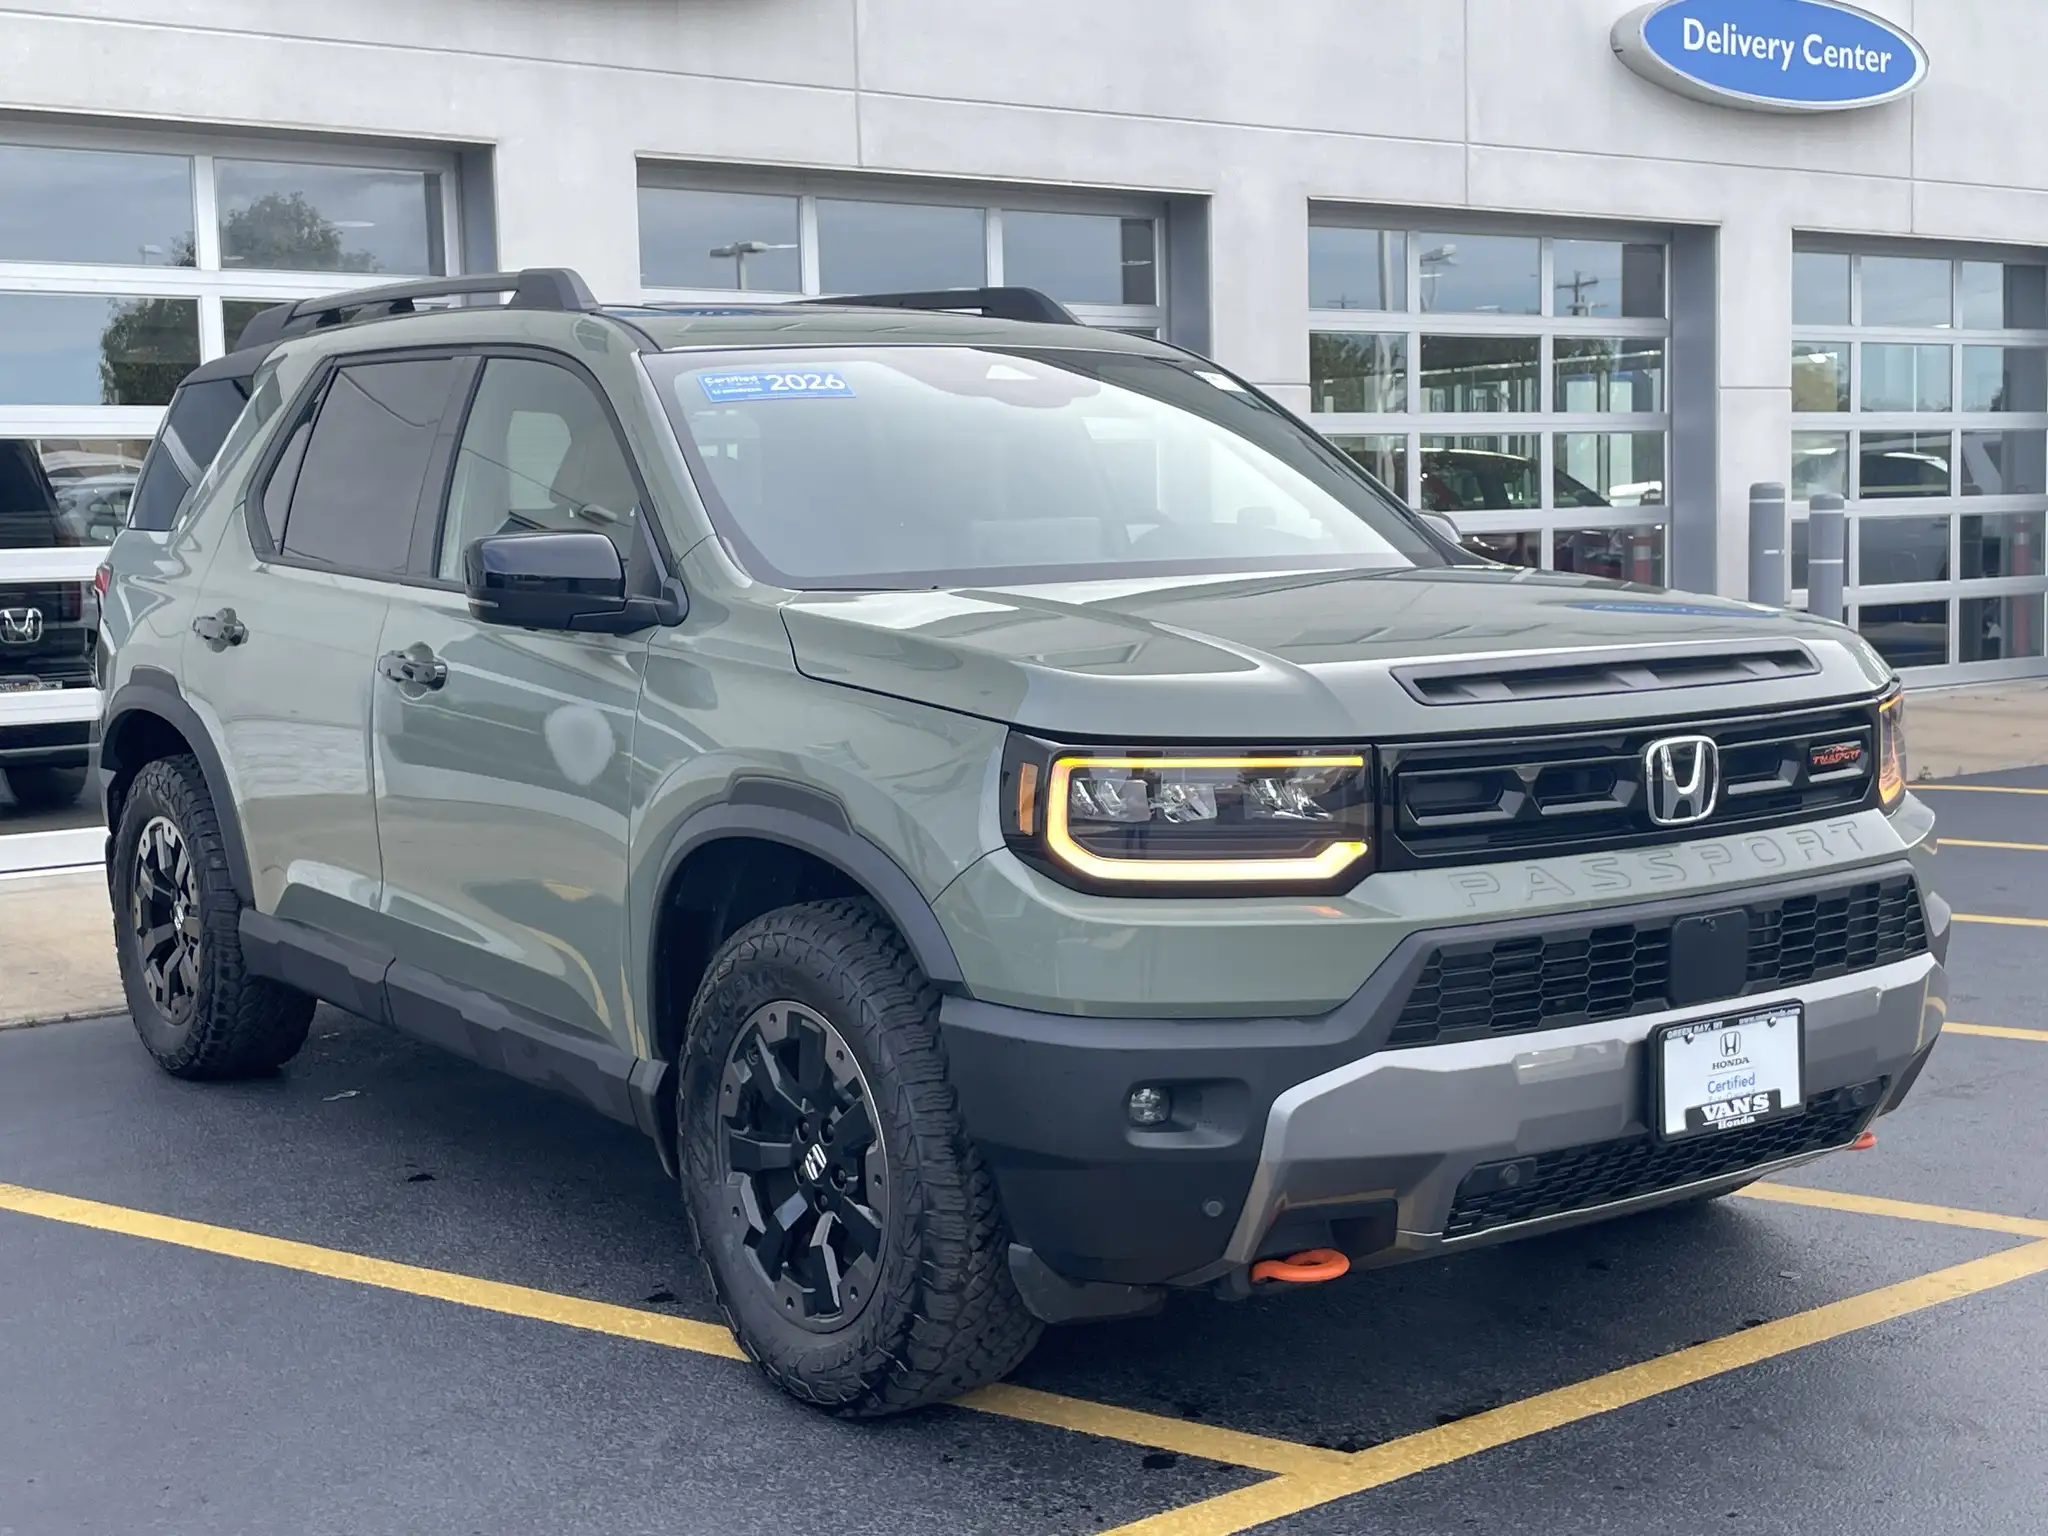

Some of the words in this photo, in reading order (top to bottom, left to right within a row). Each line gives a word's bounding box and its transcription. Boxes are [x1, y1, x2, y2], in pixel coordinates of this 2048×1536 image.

[1683, 17, 1795, 71] Delivery
[1802, 34, 1892, 73] Center
[765, 374, 846, 391] 2026
[1447, 821, 1865, 908] PASSPORT
[1712, 1057, 1750, 1070] HONDA
[1708, 1071, 1755, 1093] Certified
[1701, 1093, 1770, 1121] VANS
[1717, 1115, 1756, 1130] Honda
